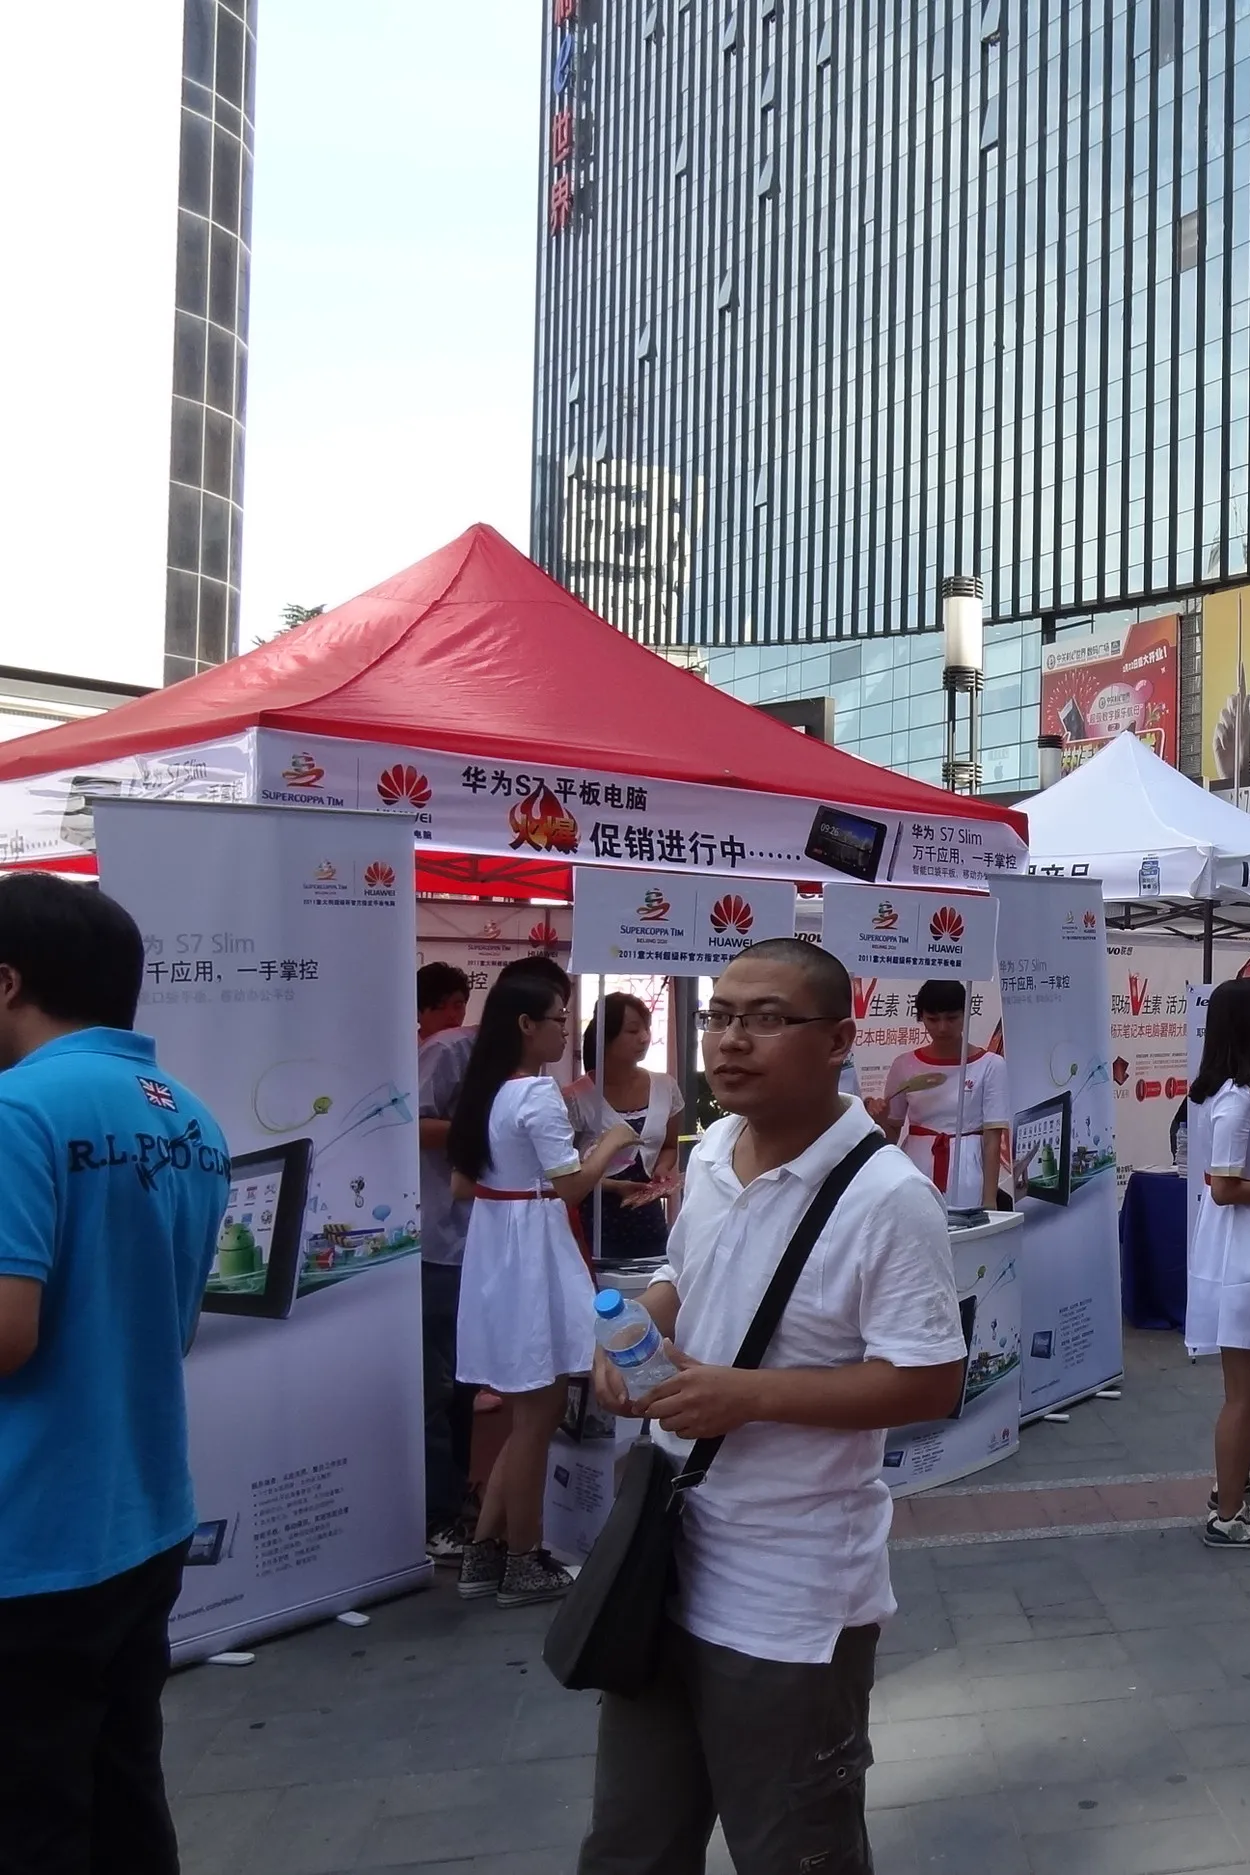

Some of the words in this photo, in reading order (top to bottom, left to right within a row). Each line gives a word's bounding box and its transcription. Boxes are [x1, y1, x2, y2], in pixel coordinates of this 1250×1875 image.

[262, 789, 326, 806] SUPERCOPPA
[327, 796, 344, 807] TIM
[911, 823, 935, 841] 华为
[940, 826, 955, 842] S7
[958, 828, 982, 846] Slim
[364, 889, 396, 897] HUAWEI
[620, 924, 670, 937] SUPERCOPPA
[670, 926, 684, 937] TIM
[176, 933, 203, 954] S7
[212, 931, 255, 955] Slim
[708, 936, 754, 948] HUAWEI
[859, 932, 898, 944] SUPERCOPPA
[898, 935, 909, 944] TIM
[928, 943, 963, 954] HUAWEI
